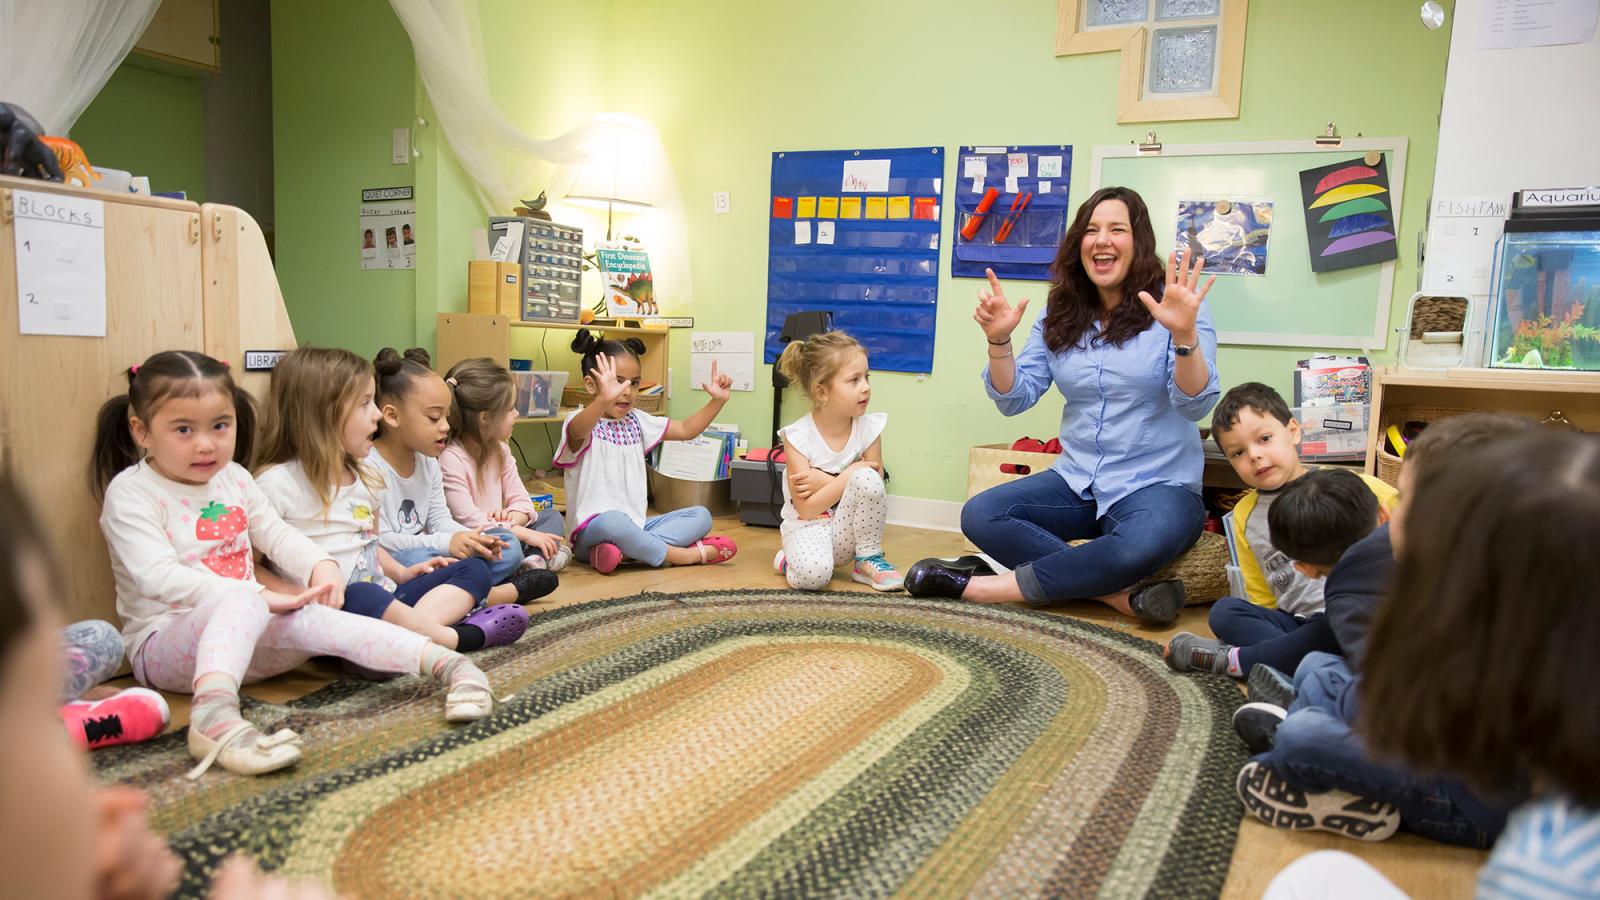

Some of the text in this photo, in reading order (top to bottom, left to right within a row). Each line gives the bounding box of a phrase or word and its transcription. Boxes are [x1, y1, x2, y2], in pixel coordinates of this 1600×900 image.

[364, 188, 411, 199] QUIET CORNER
[716, 194, 727, 209] 13
[19, 196, 92, 225] BLOCKS
[23, 240, 31, 252] 1
[601, 251, 646, 261] First Dinosaur
[387, 259, 394, 268] 2
[606, 261, 646, 271] Encyclopedia
[1446, 274, 1454, 282] 2
[26, 292, 39, 304] 2
